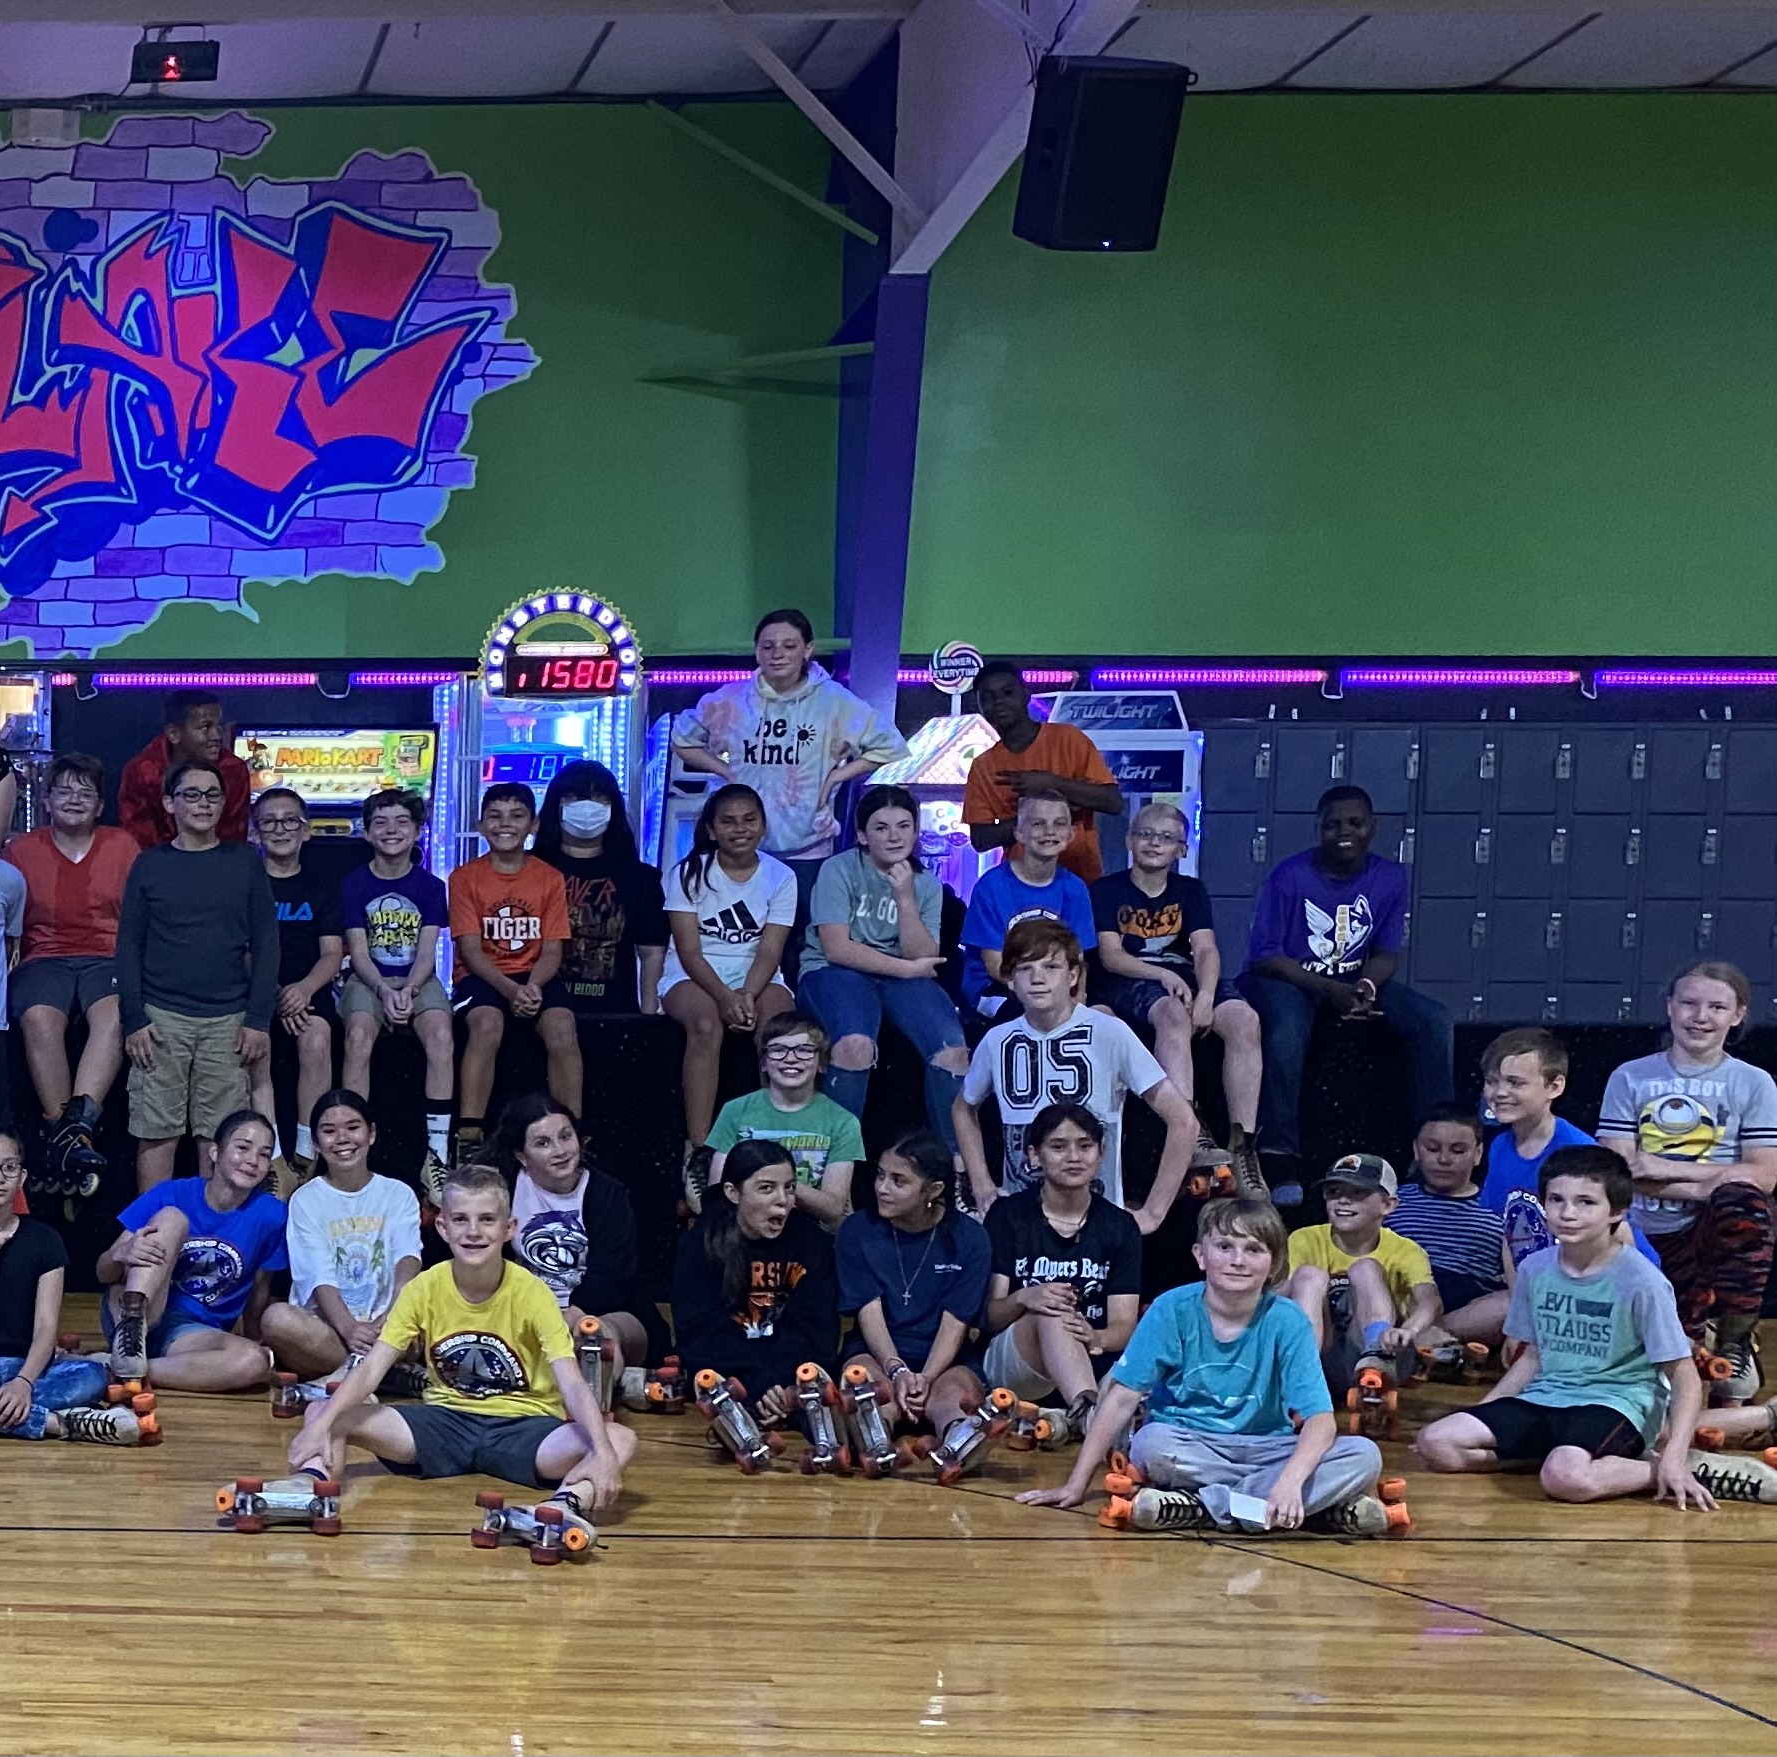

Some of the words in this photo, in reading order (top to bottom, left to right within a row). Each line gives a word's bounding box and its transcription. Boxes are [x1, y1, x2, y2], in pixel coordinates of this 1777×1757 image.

[940, 657, 973, 667] WINNER
[1073, 704, 1159, 720] TWILIGHT
[755, 717, 788, 739] be
[275, 747, 332, 768] MARIO
[330, 747, 385, 768] KART
[743, 739, 800, 766] kind
[1111, 766, 1161, 780] IGHT
[564, 875, 617, 907] AYER
[274, 901, 314, 921] ILA
[855, 893, 899, 925] LGO
[481, 916, 542, 941] TIGER
[1000, 1024, 1094, 1109] 05
[1688, 1077, 1727, 1097] BOY
[1031, 1255, 1078, 1283] Myers
